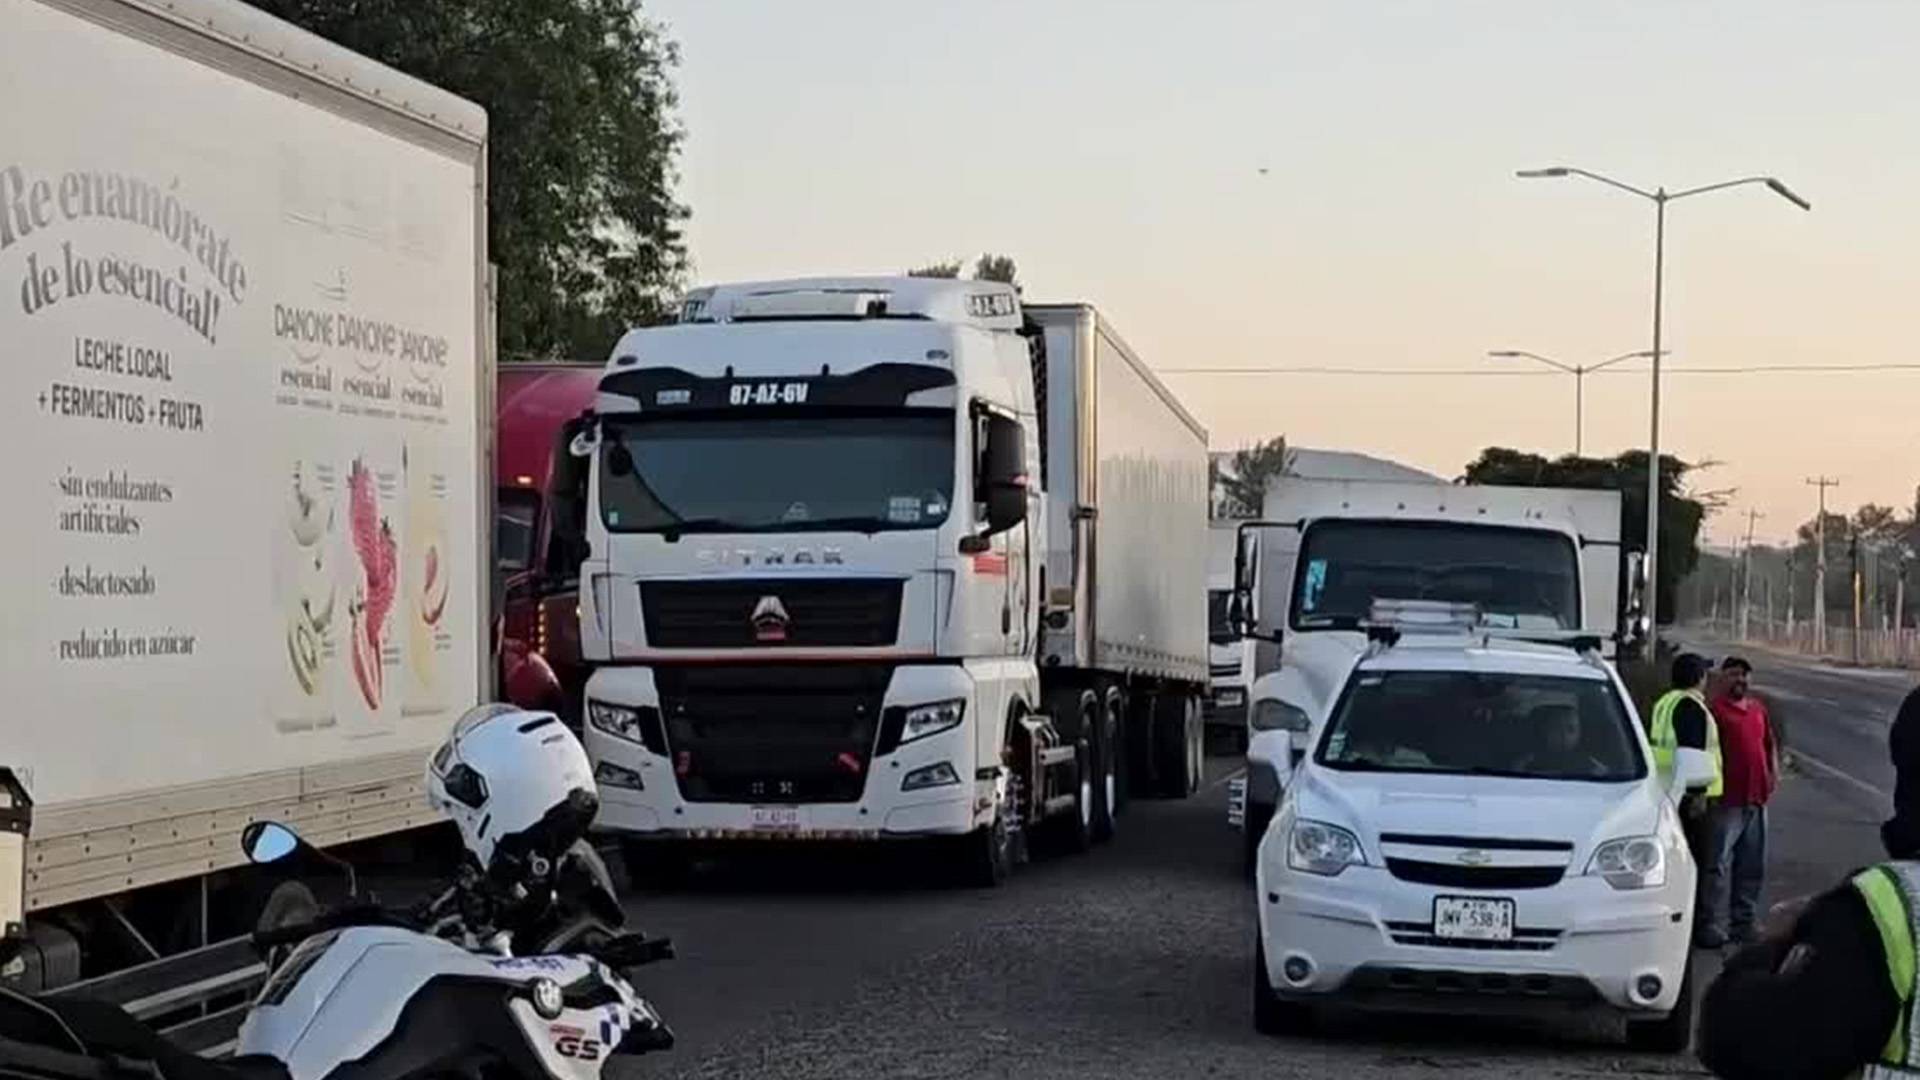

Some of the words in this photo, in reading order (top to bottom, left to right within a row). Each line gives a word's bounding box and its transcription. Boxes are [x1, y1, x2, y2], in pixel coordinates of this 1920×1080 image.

[0, 165, 52, 249] Re
[58, 171, 246, 305] enamórate
[21, 252, 60, 315] de
[62, 241, 93, 298] lo
[98, 257, 220, 345] esencial!
[274, 304, 334, 347] DANONE
[75, 336, 124, 373] LECHE
[127, 346, 173, 381] LOCAL
[51, 383, 145, 424] FERMENTOS
[159, 398, 203, 431] FRUTA
[730, 382, 809, 406] 87-AZ-GV
[58, 465, 84, 497] sin
[86, 470, 173, 503] endulzantes
[60, 503, 141, 535] artificiales
[58, 564, 156, 596] deslactosado
[60, 628, 126, 660] reducido
[128, 636, 148, 656] en
[149, 626, 195, 656] azúcar
[555, 1036, 600, 1060] GS
